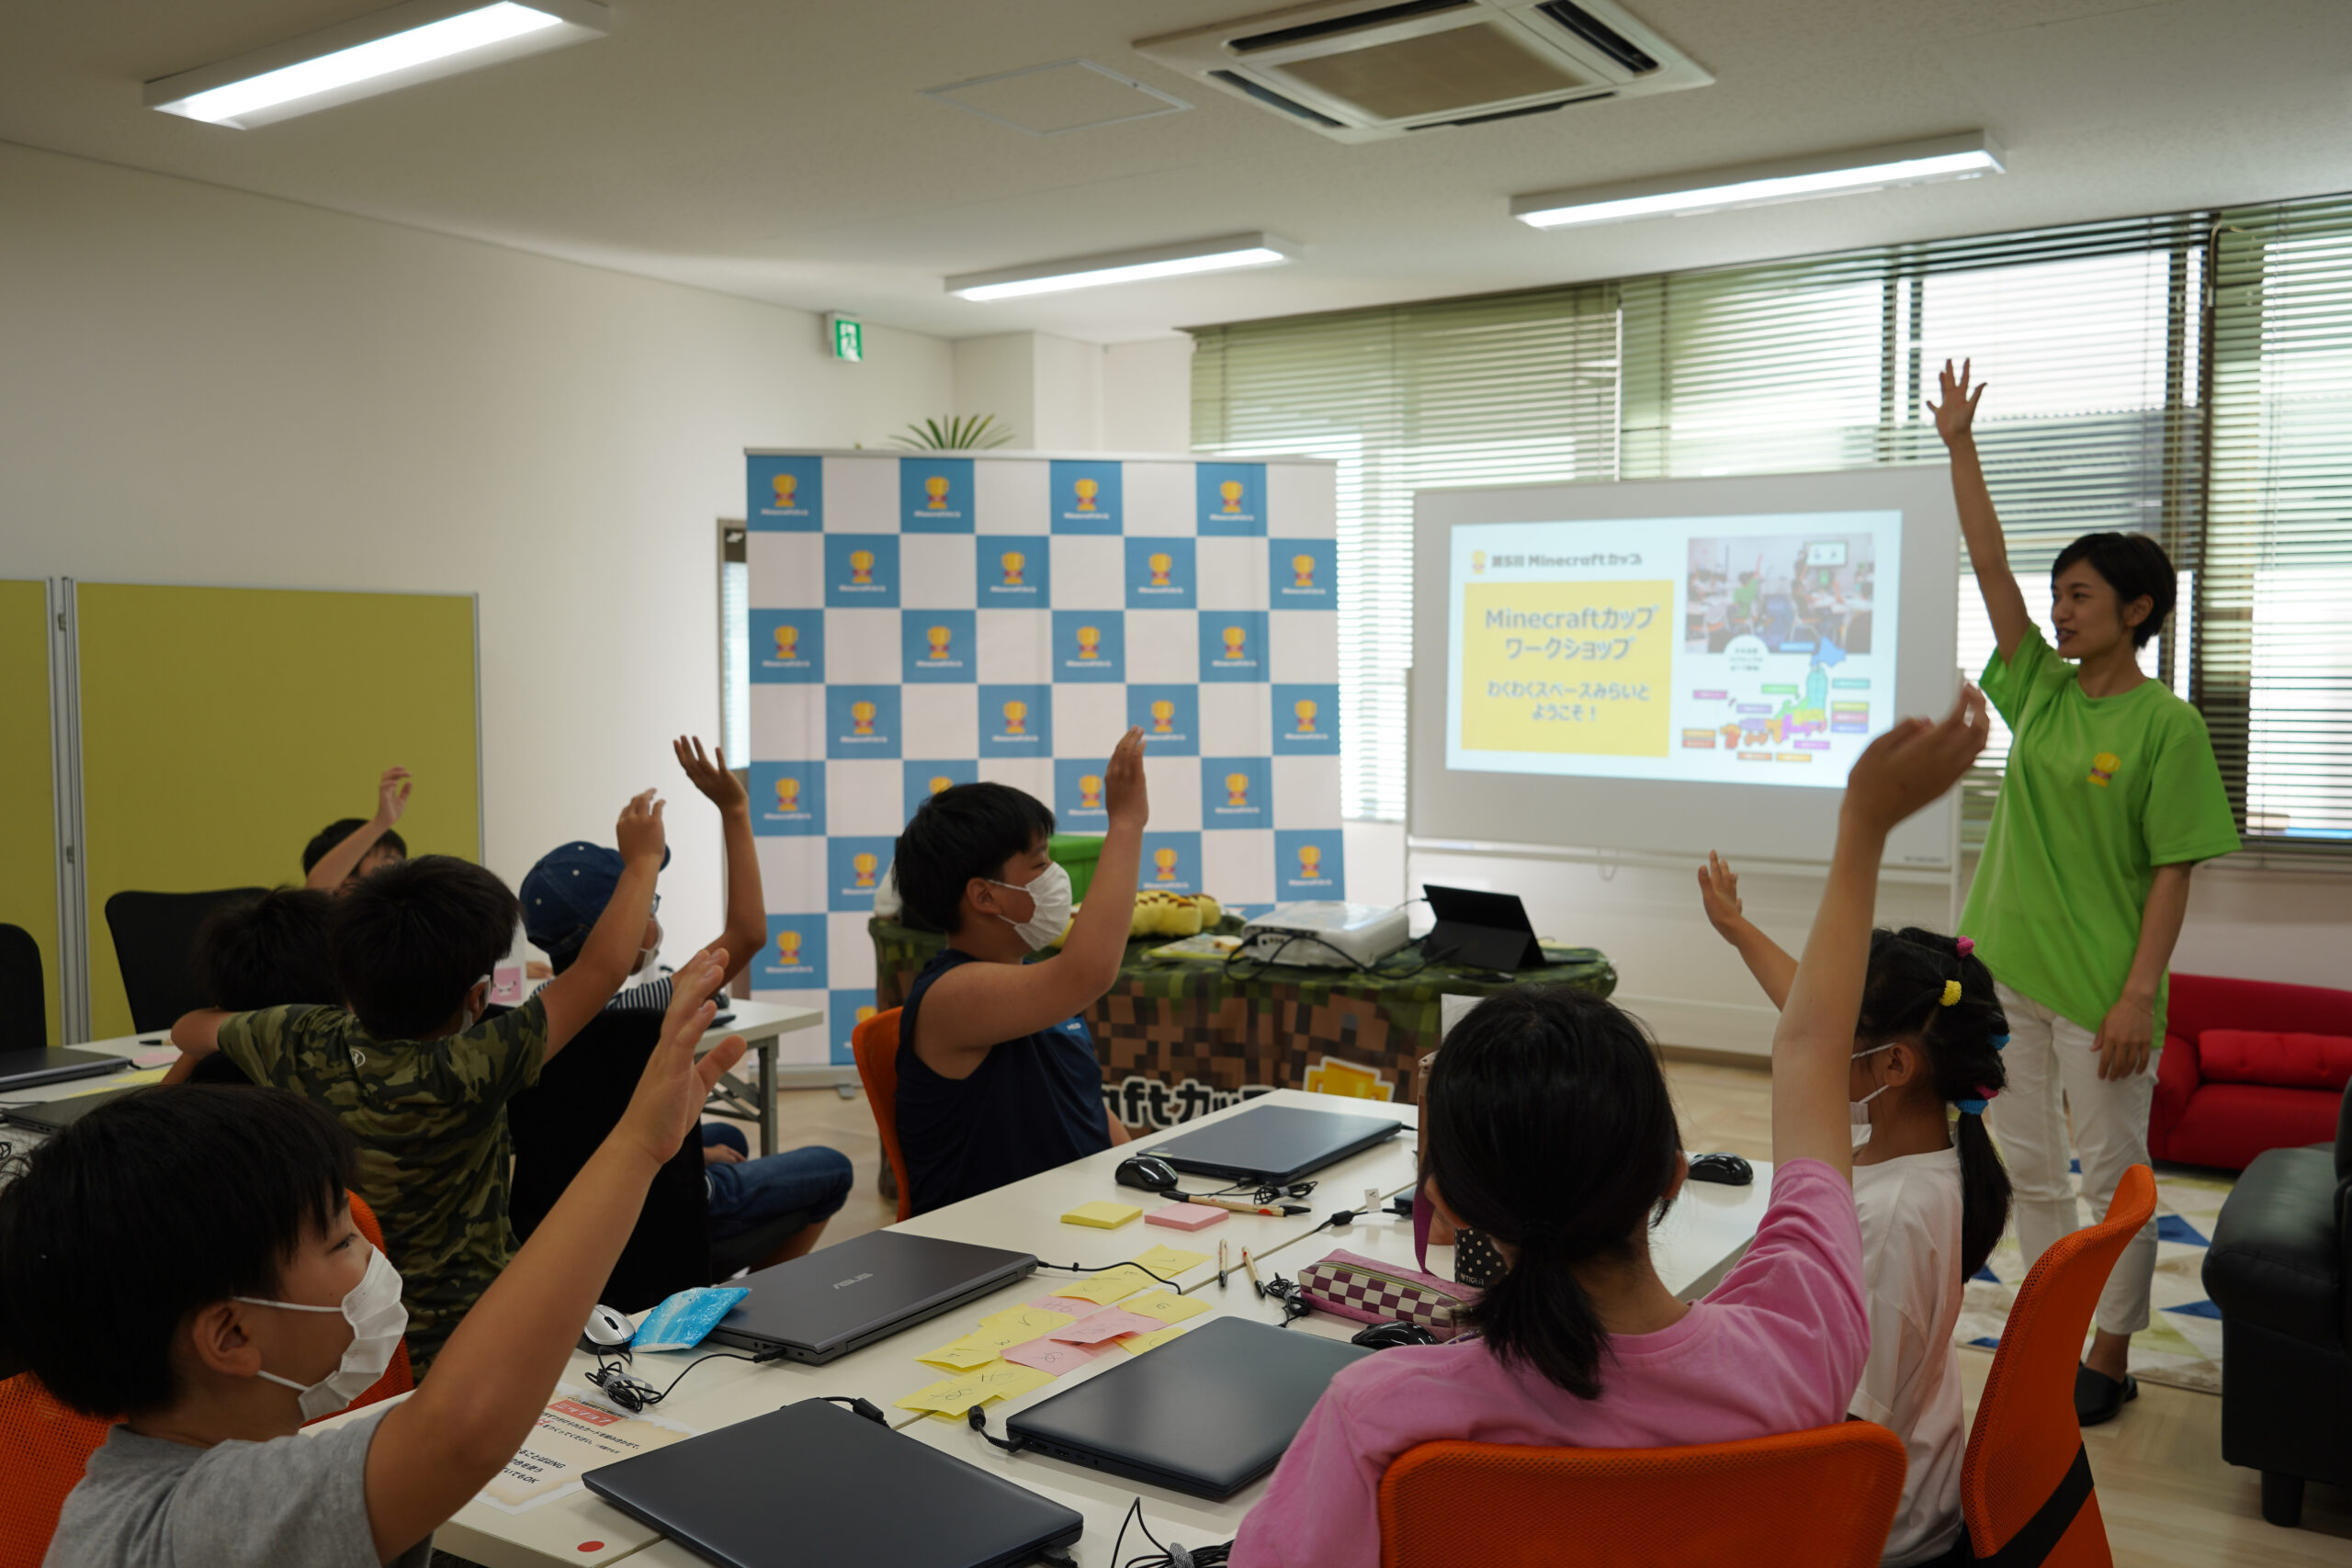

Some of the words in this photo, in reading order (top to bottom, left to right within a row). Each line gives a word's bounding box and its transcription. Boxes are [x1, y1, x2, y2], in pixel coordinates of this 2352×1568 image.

[1485, 604, 1660, 630] Minecraftカップ
[1505, 636, 1636, 660] ワークショップ
[1487, 681, 1650, 701] わくわくスペースみらいと
[833, 1273, 874, 1290] ASUS
